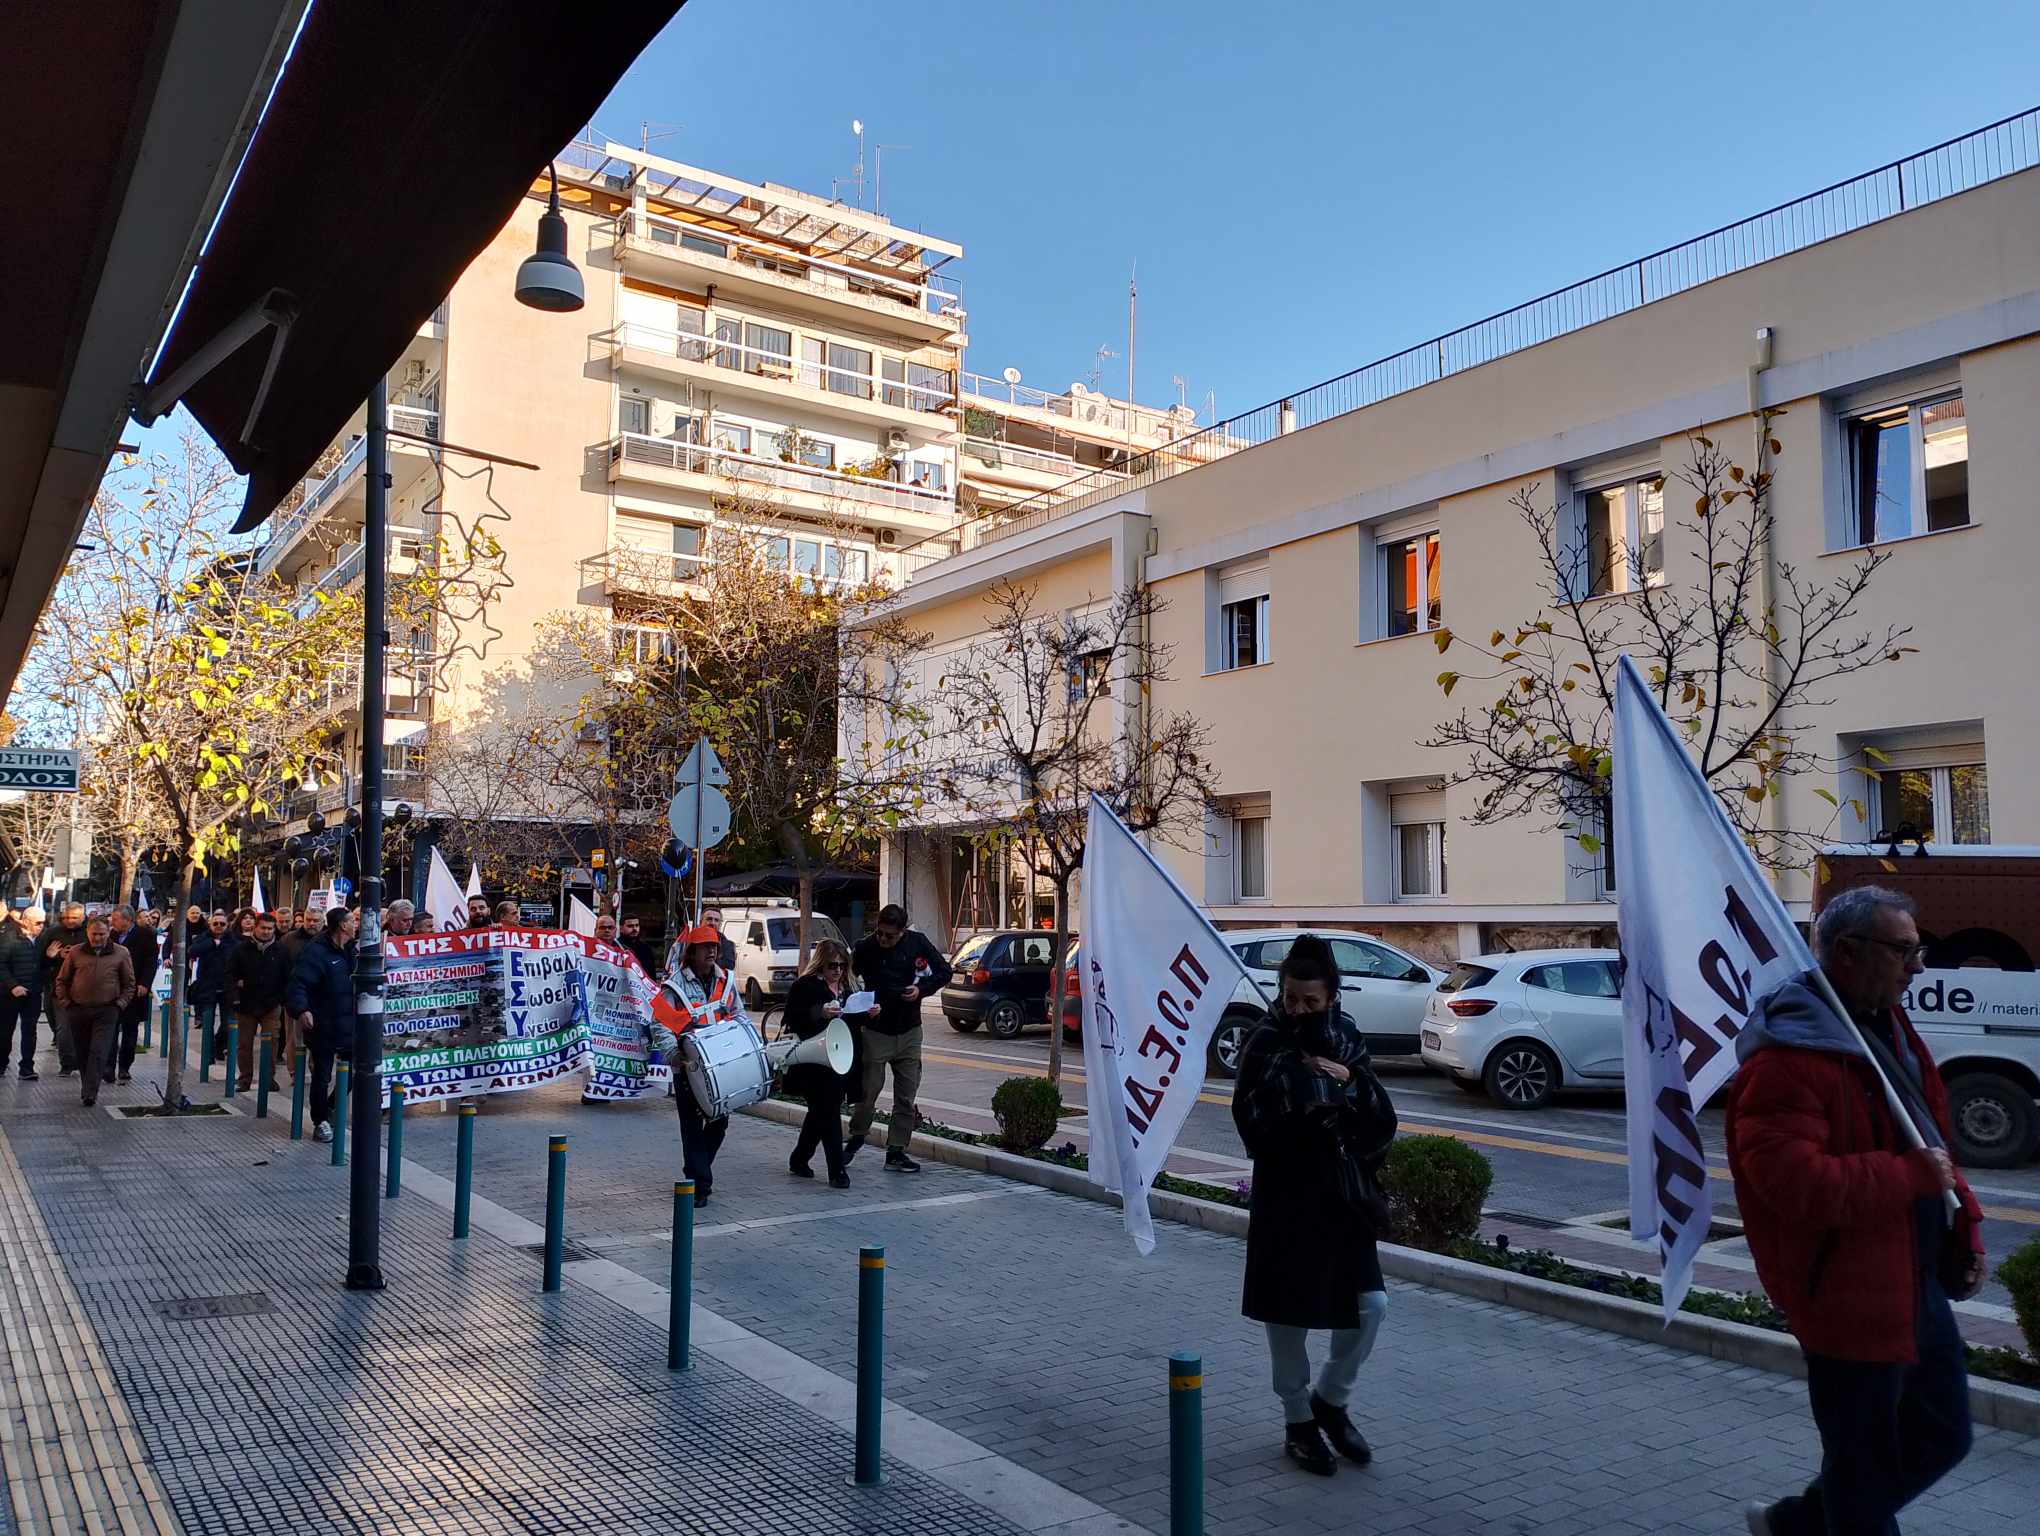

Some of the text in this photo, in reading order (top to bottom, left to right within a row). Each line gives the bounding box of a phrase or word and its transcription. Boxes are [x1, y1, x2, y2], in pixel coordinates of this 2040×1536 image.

[404, 937, 453, 956] ΤΗΣ
[458, 931, 532, 950] ΥΓΕΙΑΣ
[442, 964, 485, 981] ΖΗΜΙΩΝ
[407, 992, 480, 1010] ΥΠΟΣΤΗΡΙΞΗΣ
[408, 1016, 459, 1032] ΠΟΕΔΗΝ
[511, 1010, 560, 1038] Υγεία
[399, 1051, 450, 1071] ΧΩΡΑΣ
[453, 1042, 534, 1063] ΠΑΛΕΥΟΥΜΕ
[536, 1036, 559, 1052] ΓΙΑ
[420, 1067, 466, 1084] ΤΩΝ
[472, 1052, 561, 1077] ΠΟΛΙΤΩΝ
[489, 1057, 583, 1089] ΑΓΩΝΑΣ
